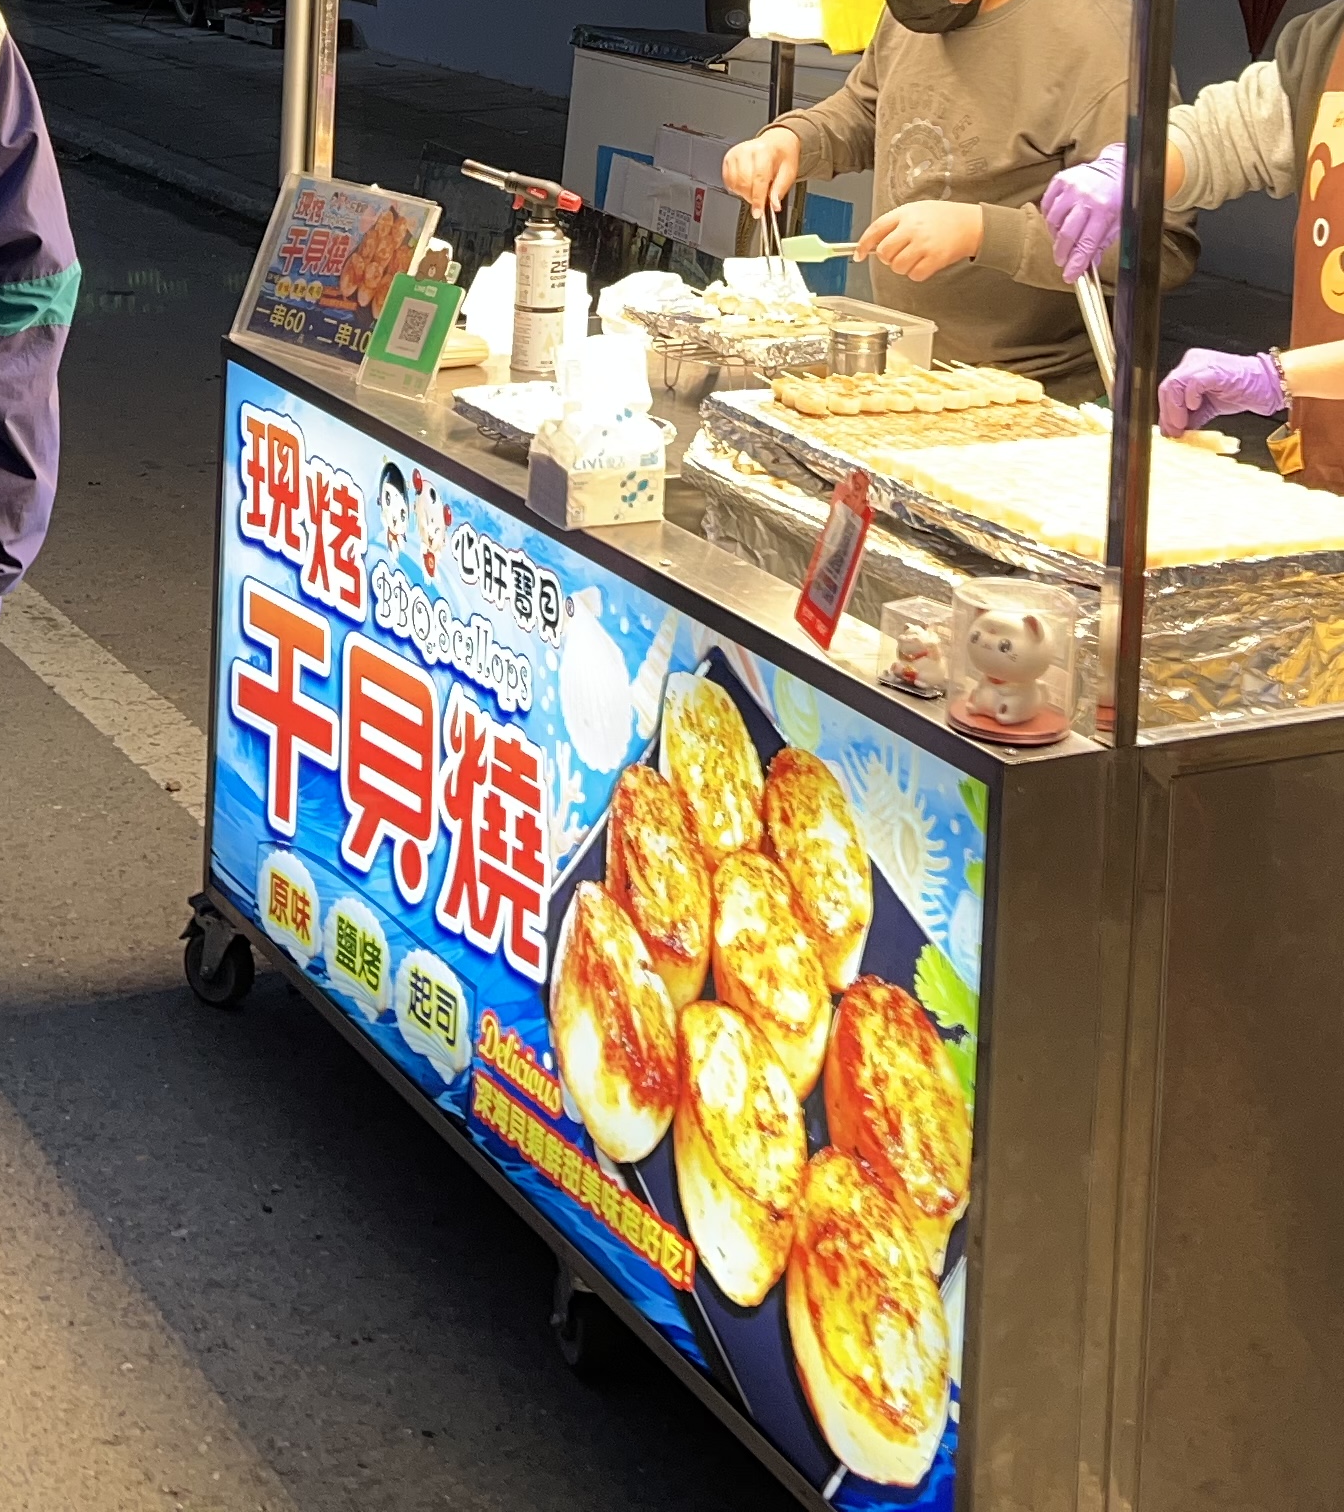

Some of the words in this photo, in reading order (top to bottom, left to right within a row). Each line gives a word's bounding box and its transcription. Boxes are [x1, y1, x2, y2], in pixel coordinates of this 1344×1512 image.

[279, 226, 352, 275] 干貝燒
[246, 415, 362, 609] 現烤
[455, 530, 561, 641] 心肝寶貝
[376, 571, 437, 653] BBQ
[438, 609, 532, 702] Scallops
[237, 590, 545, 969] 干貝燒
[268, 871, 311, 941] 原味
[335, 914, 382, 992] 鹽烤
[408, 966, 457, 1047] 起司
[478, 1014, 562, 1115] Delicious
